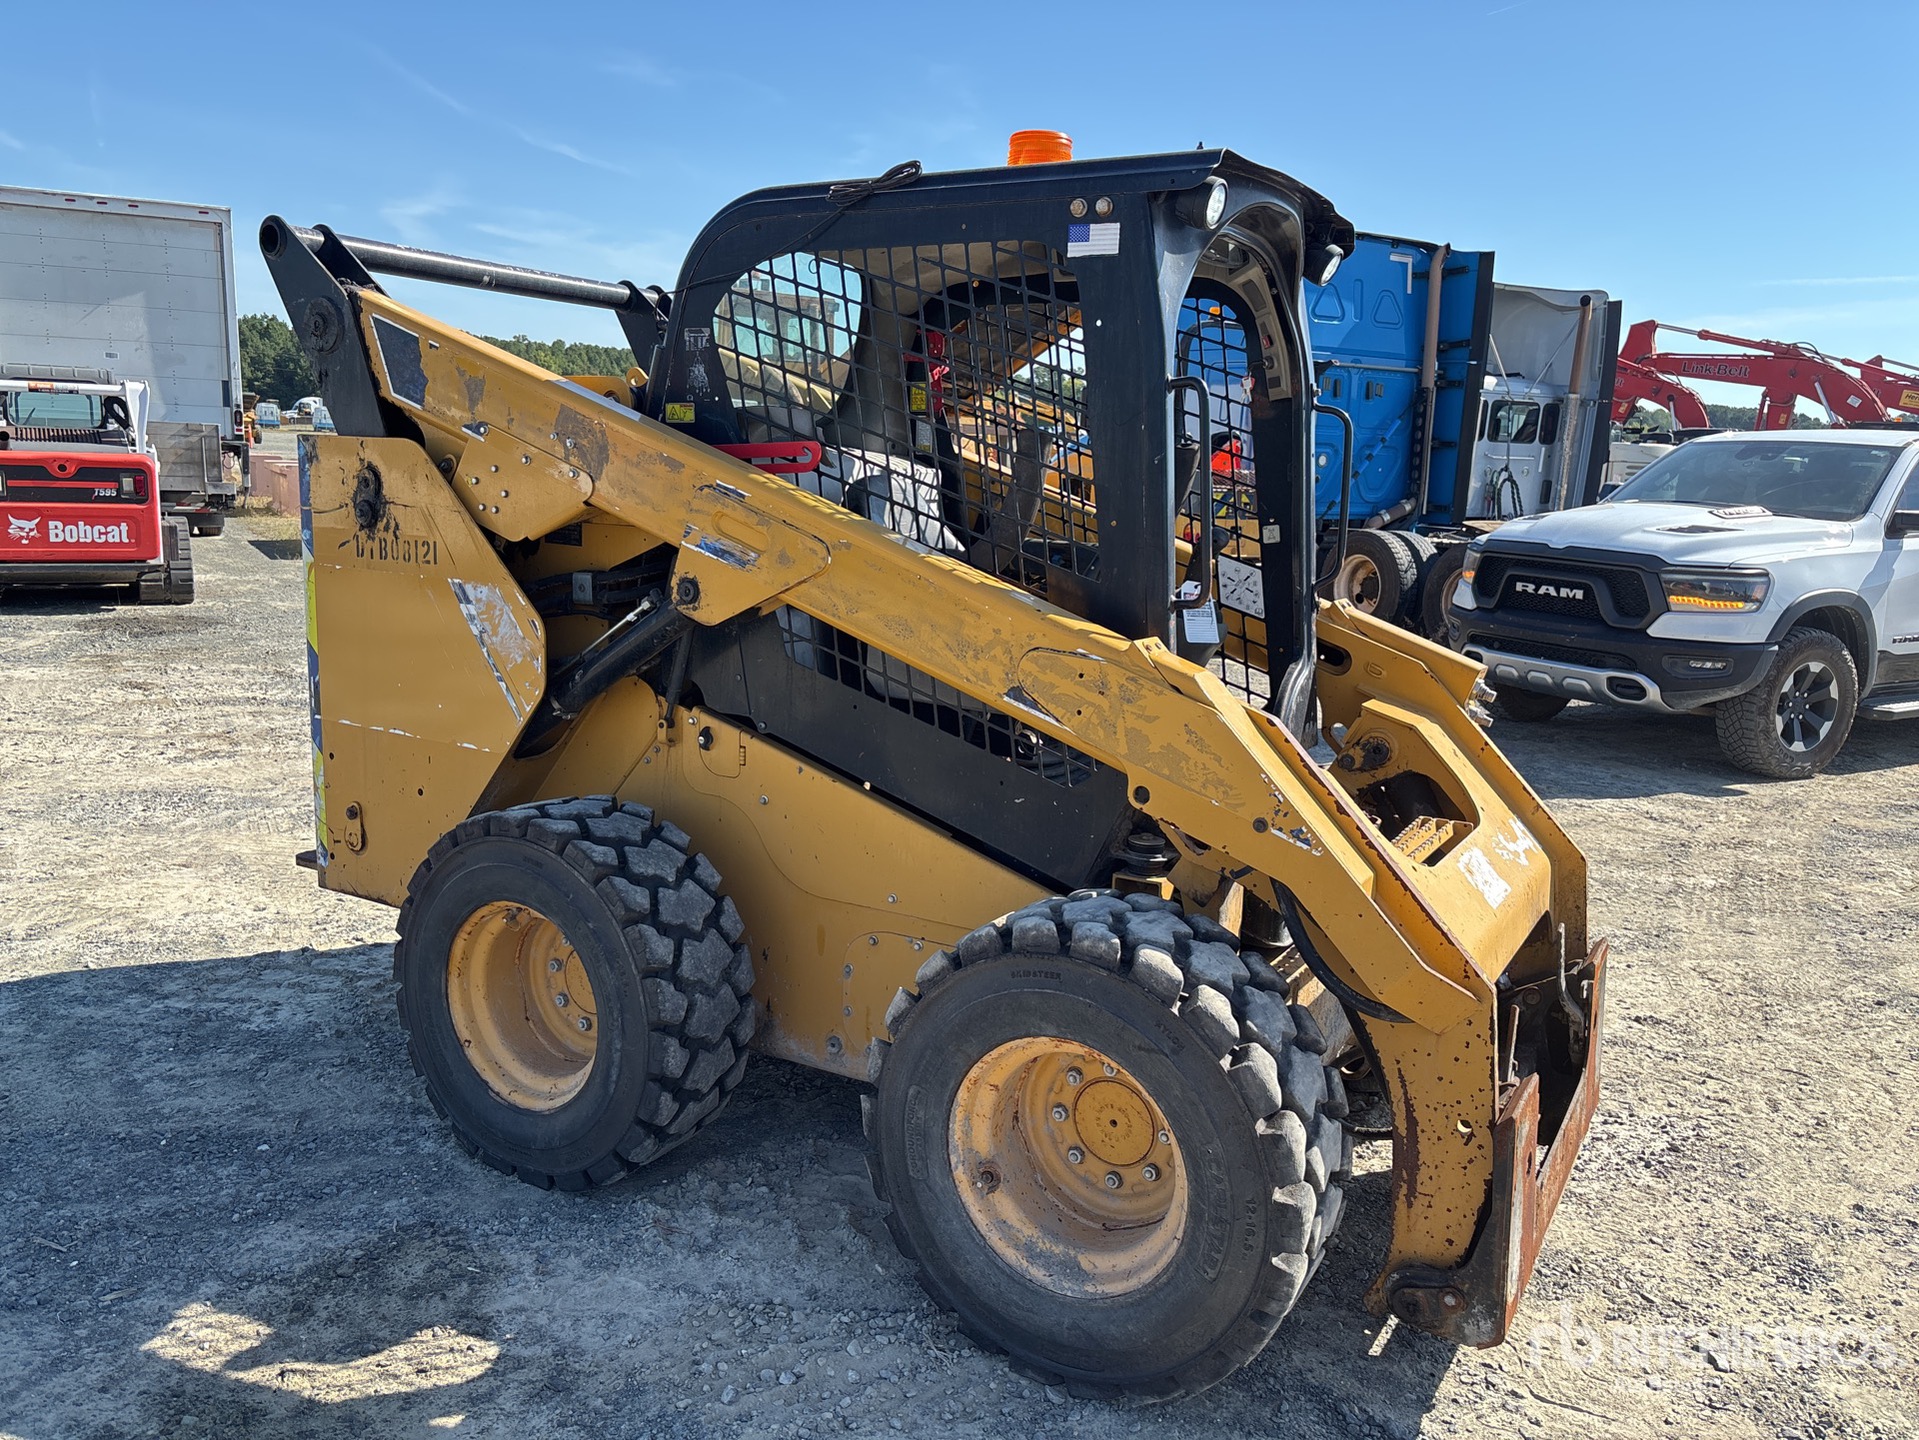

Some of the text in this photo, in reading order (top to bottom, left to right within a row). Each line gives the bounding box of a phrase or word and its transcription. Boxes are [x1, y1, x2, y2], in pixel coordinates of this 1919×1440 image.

[1682, 361, 1750, 378] Link-Belt
[93, 488, 117, 497] T595
[48, 521, 129, 543] Bobcat
[1515, 581, 1584, 600] RAM
